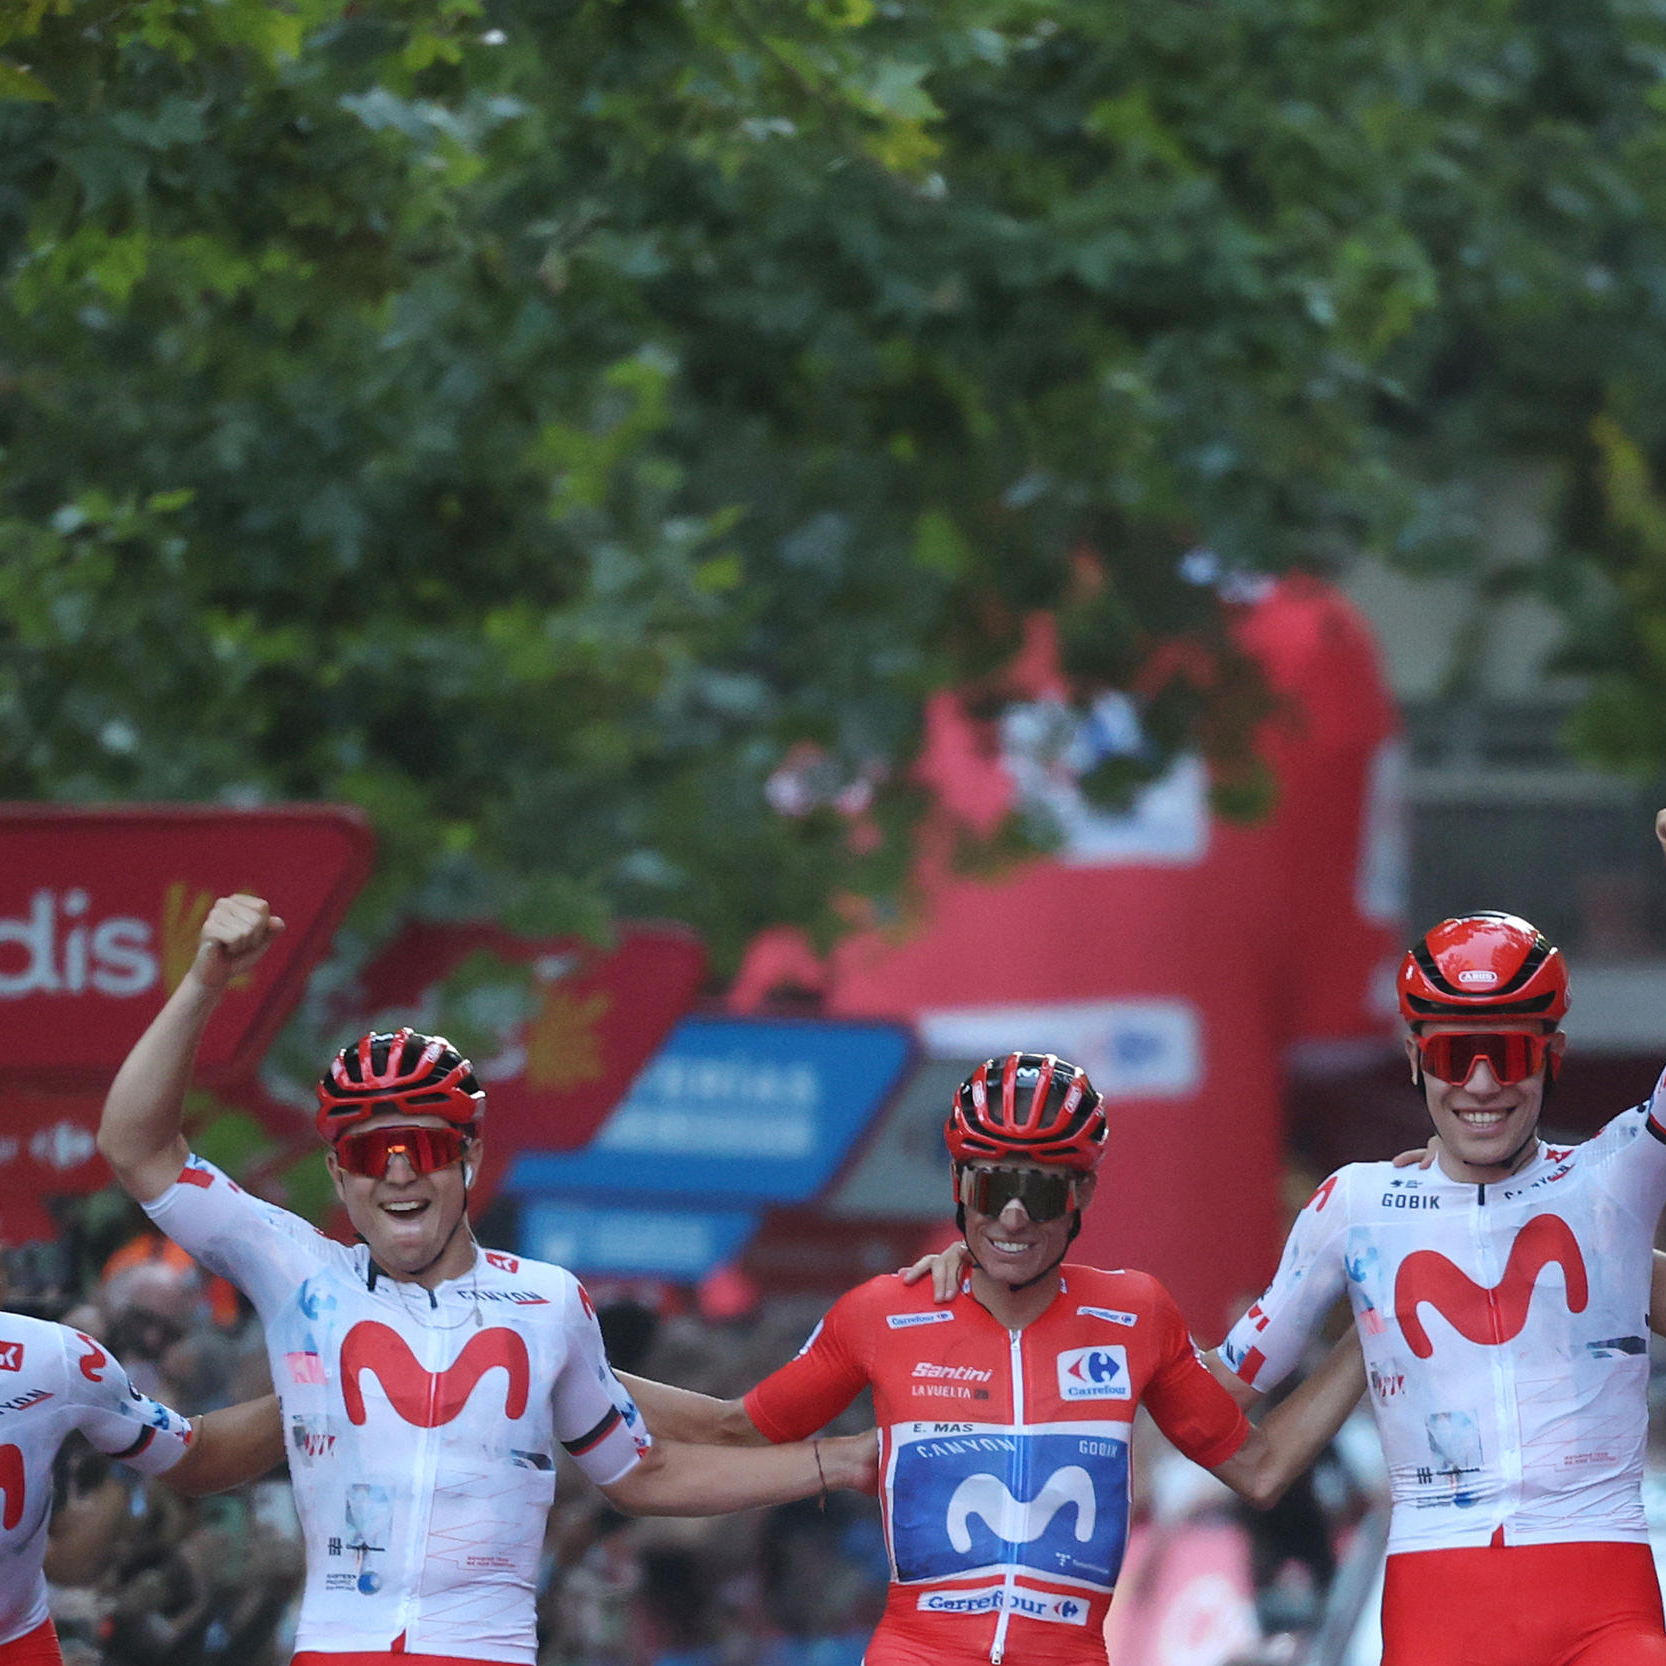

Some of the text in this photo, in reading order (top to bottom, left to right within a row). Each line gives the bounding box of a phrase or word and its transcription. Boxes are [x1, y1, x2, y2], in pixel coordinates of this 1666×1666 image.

[1381, 1192, 1440, 1210] GOBIK
[456, 1289, 543, 1302] CANYON
[911, 1361, 993, 1383] Santini
[1068, 1384, 1126, 1397] Carrefour
[934, 1423, 974, 1433] MAS
[916, 1437, 1016, 1459] CANYON
[1079, 1440, 1118, 1459] GOBIK
